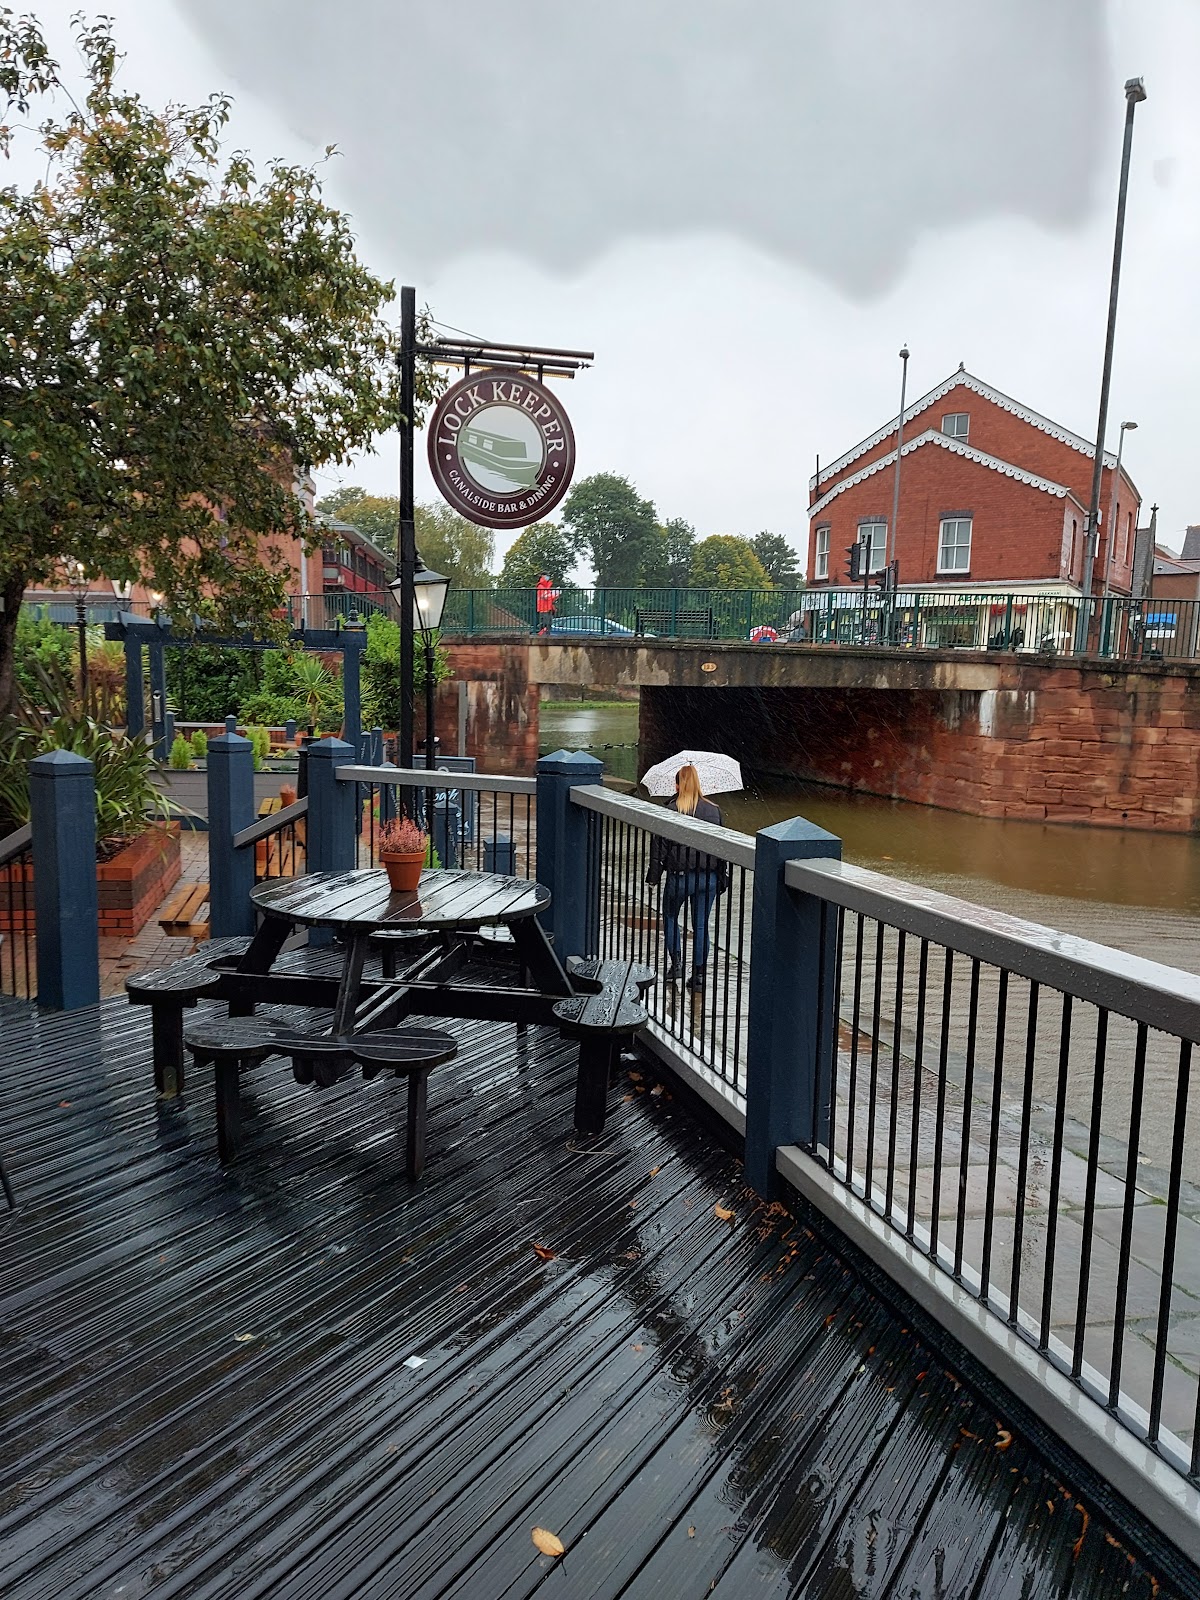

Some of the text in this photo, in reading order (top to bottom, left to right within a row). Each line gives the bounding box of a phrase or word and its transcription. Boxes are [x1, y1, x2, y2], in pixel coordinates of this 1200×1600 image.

[438, 381, 565, 454] LOCK KEEPER
[448, 469, 556, 513] CANALSIDE BAR & DINING
